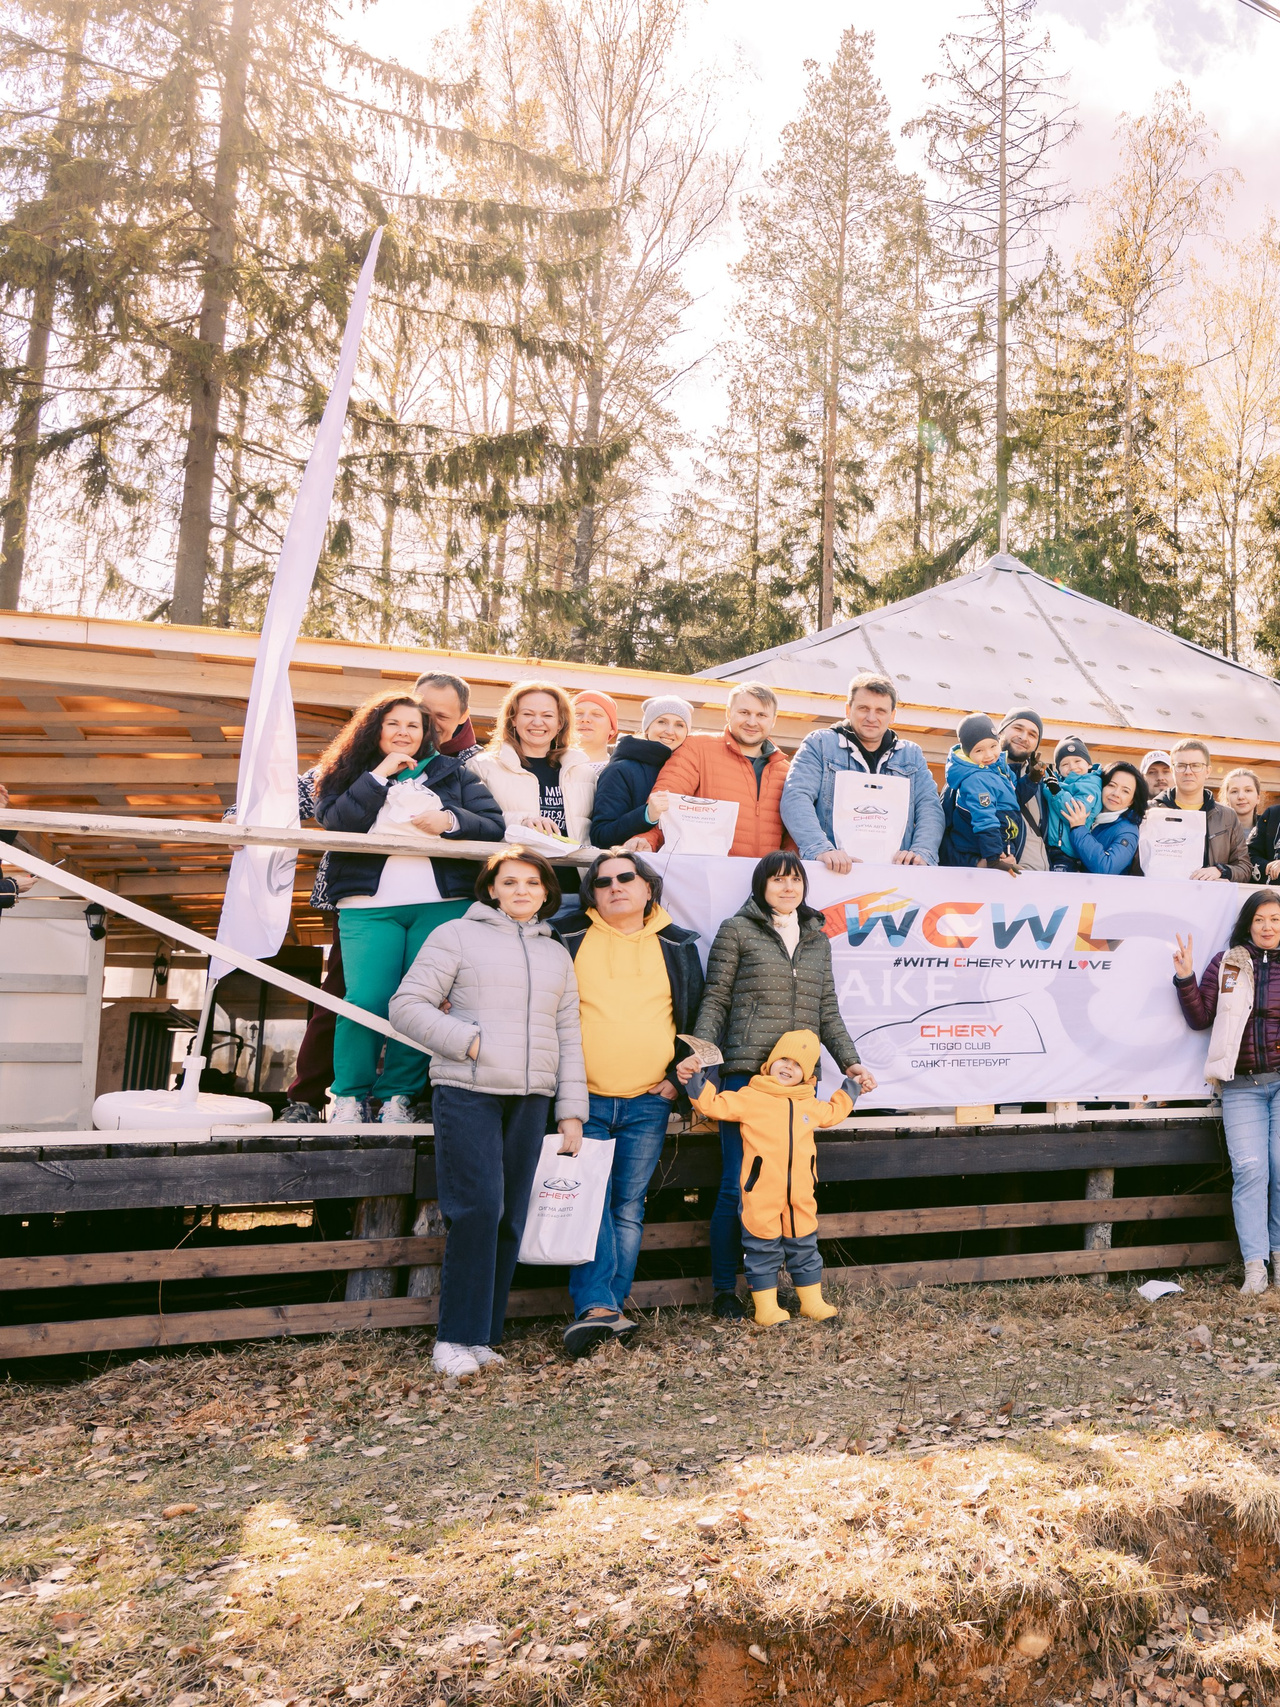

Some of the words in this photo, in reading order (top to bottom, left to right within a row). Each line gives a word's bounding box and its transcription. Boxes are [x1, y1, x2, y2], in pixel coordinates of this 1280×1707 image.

[545, 785, 562, 797] МН
[544, 797, 563, 806] КРЫЛ
[678, 804, 718, 813] CHERY
[844, 901, 1125, 952] WCWL
[893, 957, 949, 968] #WITH
[953, 957, 1016, 969] CHERY
[1019, 959, 1062, 970] WITH
[840, 968, 958, 1007] AKE
[920, 1024, 1004, 1038] CHERY
[929, 1042, 962, 1051] TIGGO
[964, 1041, 991, 1051] CLUB
[910, 1058, 1011, 1069] САНКТ-ПЕТЕРБУРГ
[539, 1191, 579, 1200] CHERY
